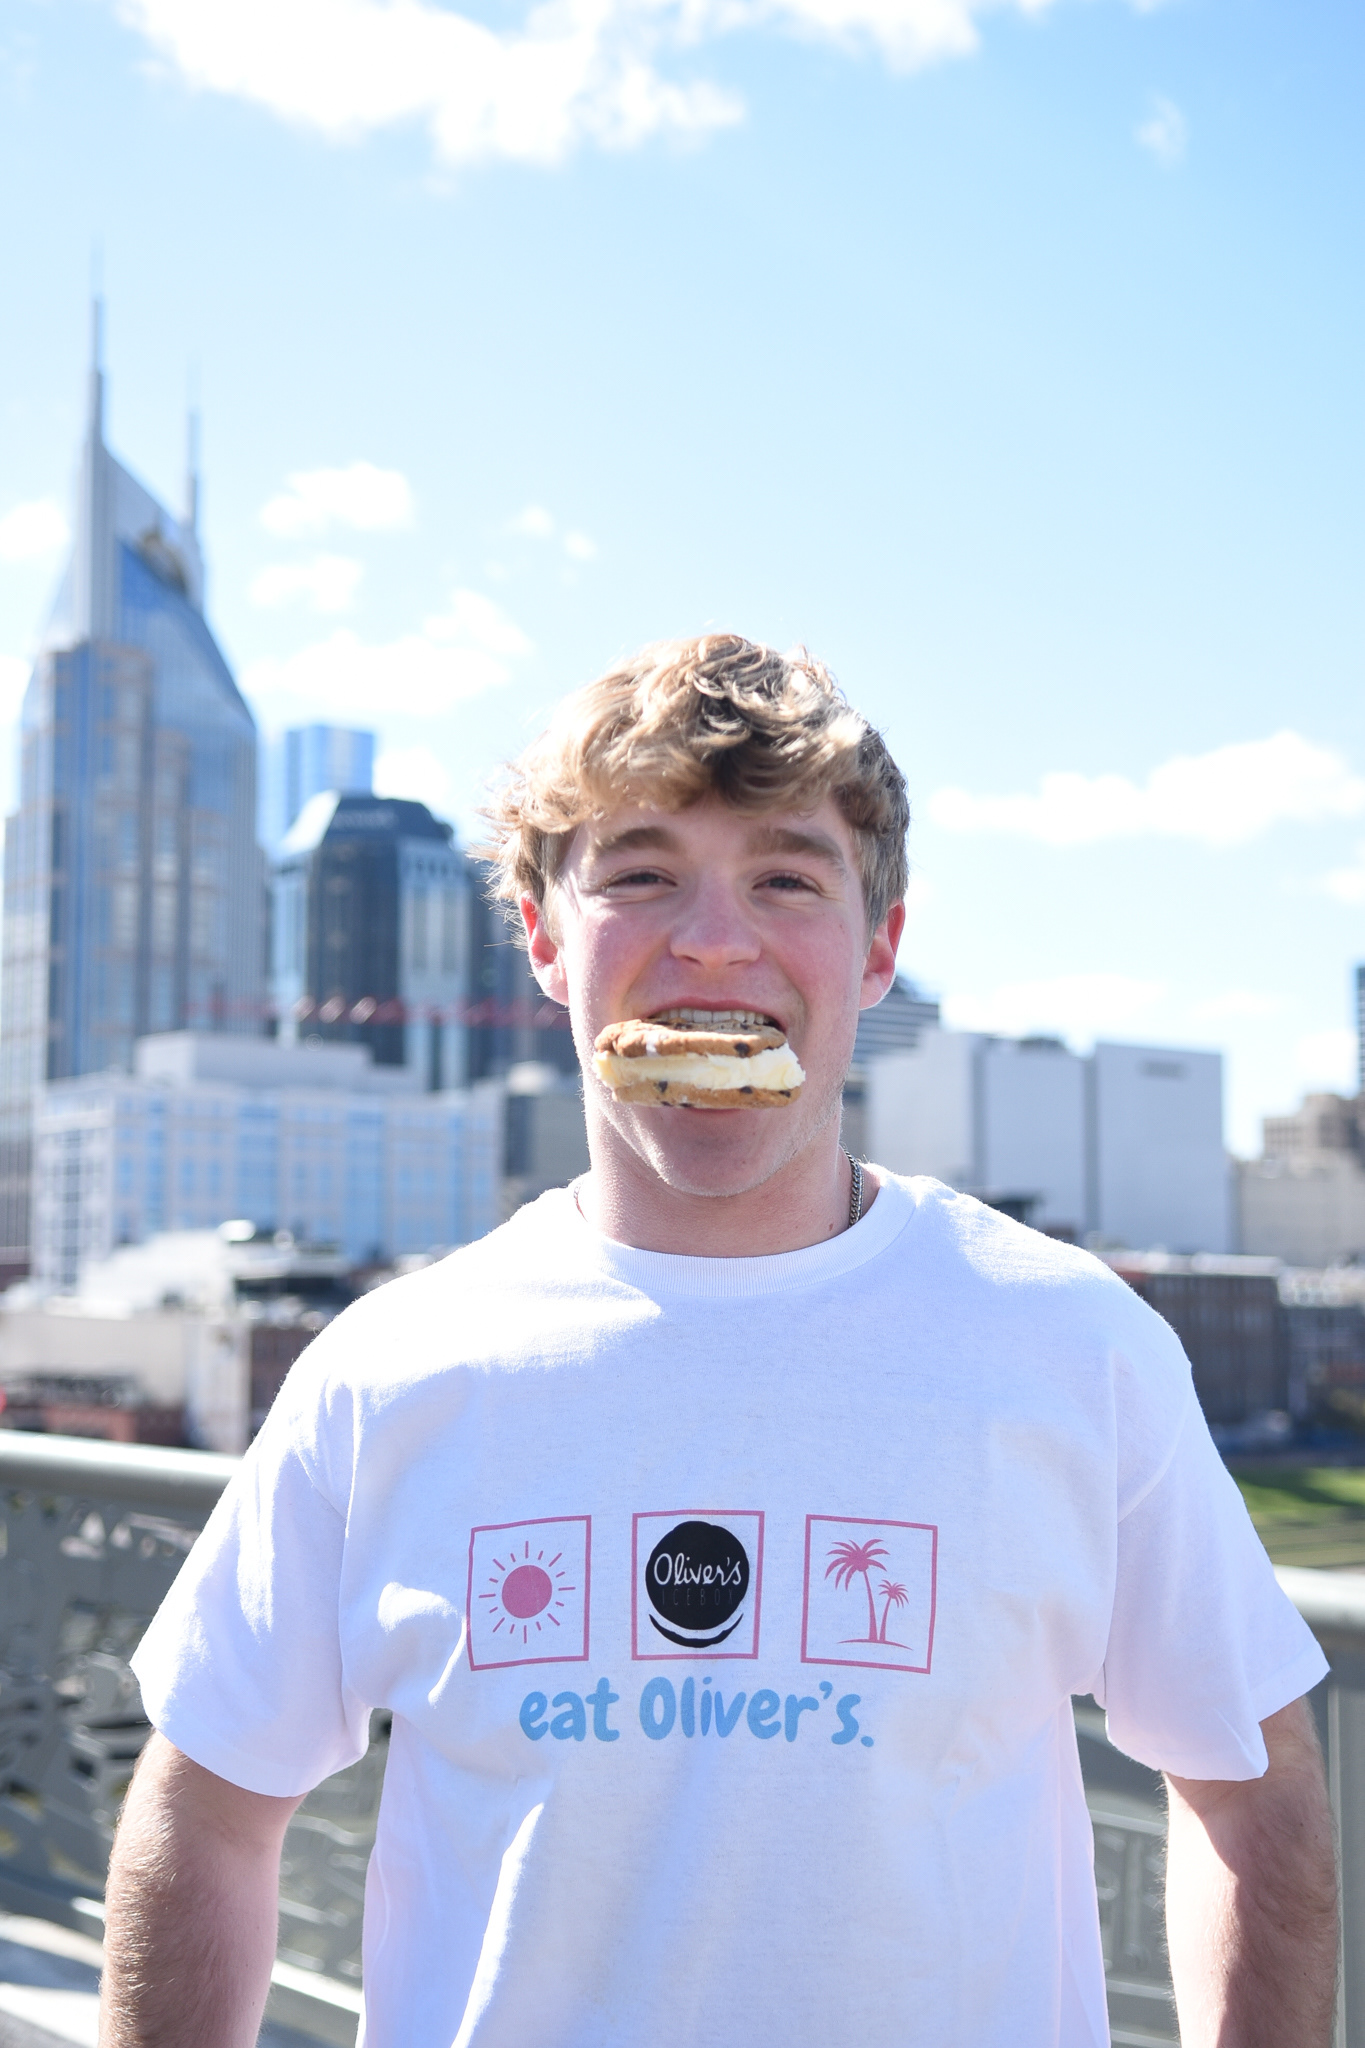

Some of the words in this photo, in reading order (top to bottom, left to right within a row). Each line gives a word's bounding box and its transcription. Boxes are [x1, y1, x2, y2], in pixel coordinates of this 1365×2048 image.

[653, 1552, 742, 1586] Oliver's
[661, 1588, 733, 1606] ICEBOX
[519, 1676, 620, 1743] eat
[639, 1676, 875, 1748] Oliver's.
